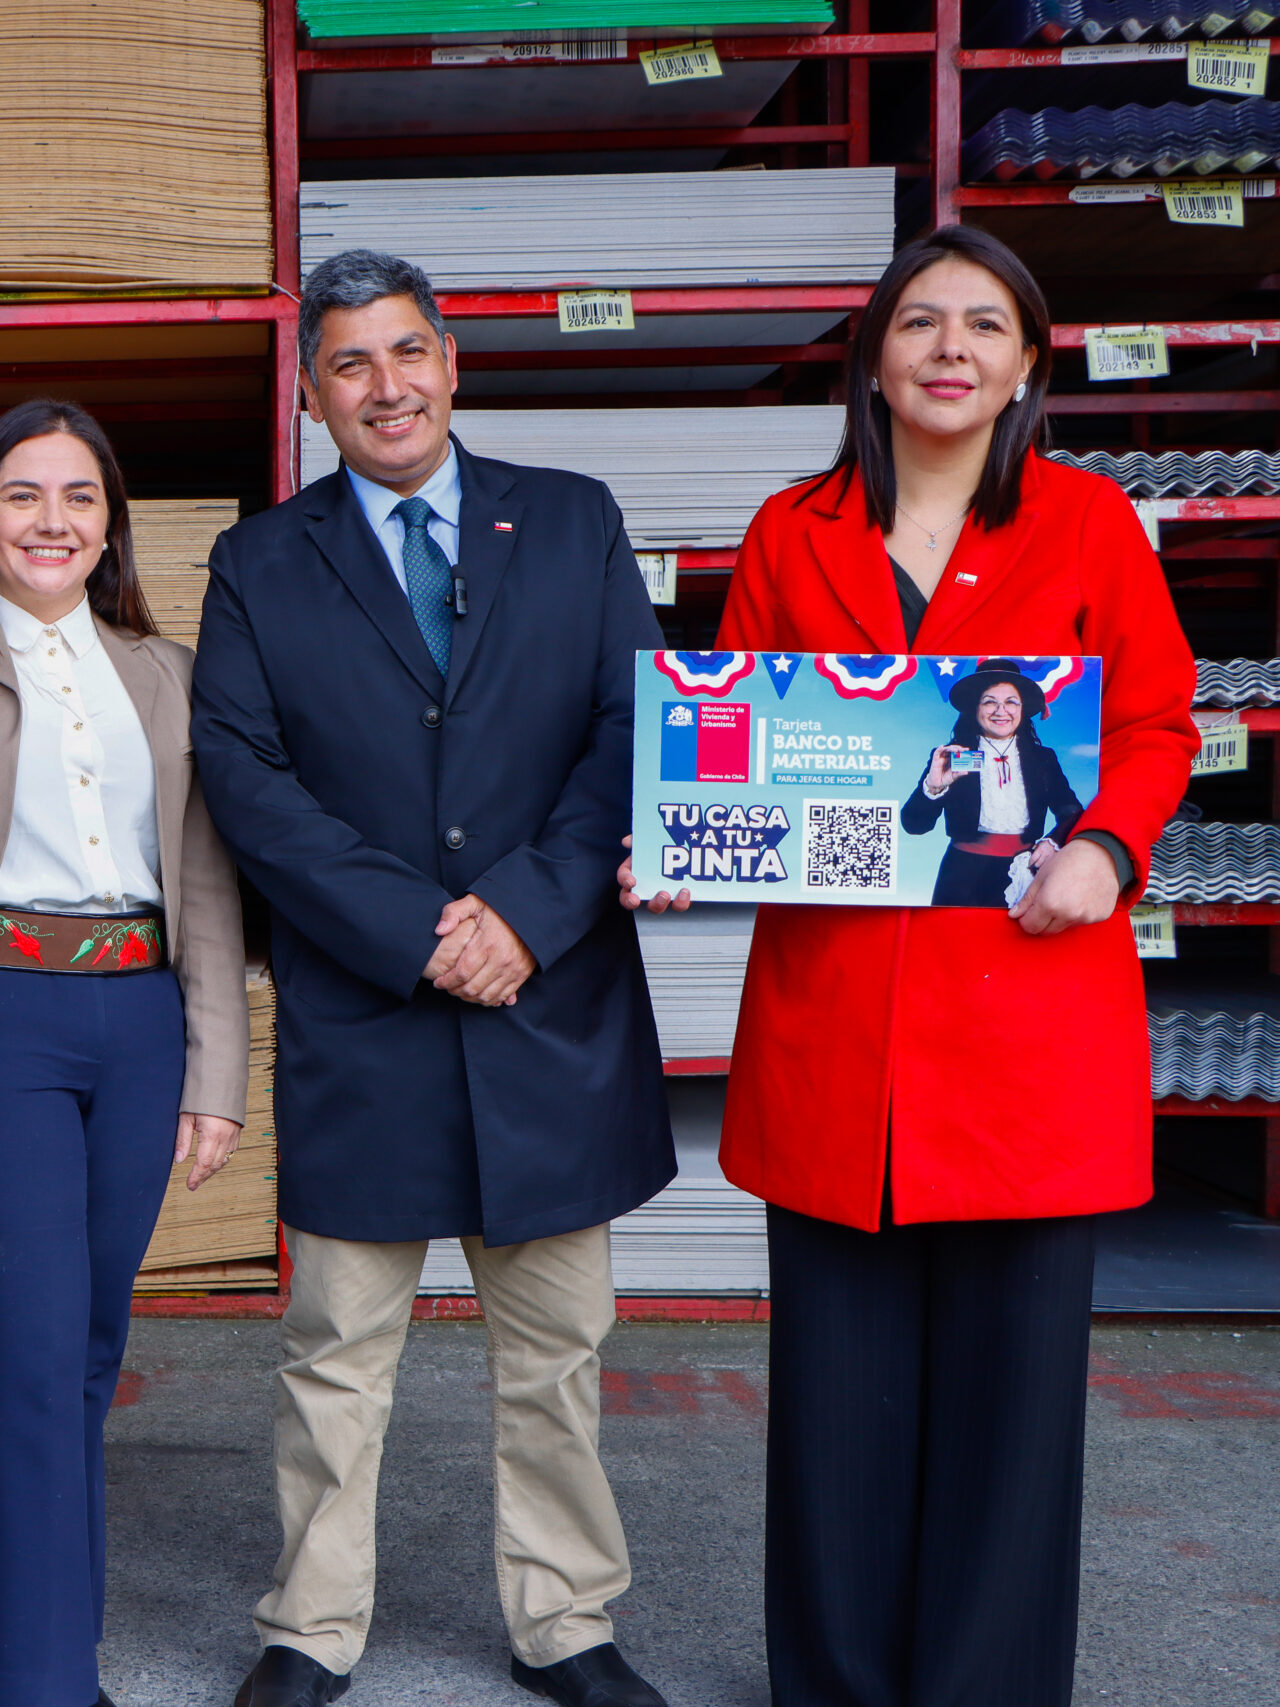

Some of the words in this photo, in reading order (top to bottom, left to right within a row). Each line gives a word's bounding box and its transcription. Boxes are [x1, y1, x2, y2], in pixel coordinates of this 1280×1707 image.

[513, 46, 551, 56] 209172
[1148, 43, 1188, 54] 202851
[655, 67, 694, 79] 202980
[1196, 74, 1236, 86] 202852
[1176, 210, 1216, 219] 202853
[568, 317, 607, 327] 202462
[1099, 361, 1139, 372] 202143
[773, 718, 821, 733] Tarjeta
[772, 734, 843, 750] BANCO
[847, 735, 872, 751] DE
[772, 753, 891, 771] MATERIALES
[1192, 759, 1218, 769] 2145
[776, 775, 797, 783] PARA
[824, 776, 835, 784] DE
[837, 776, 867, 784] HOGAR
[659, 804, 701, 827] TU
[705, 805, 790, 829] CASA
[701, 829, 718, 846] A
[722, 830, 751, 846] TU
[662, 846, 787, 878] PINTA
